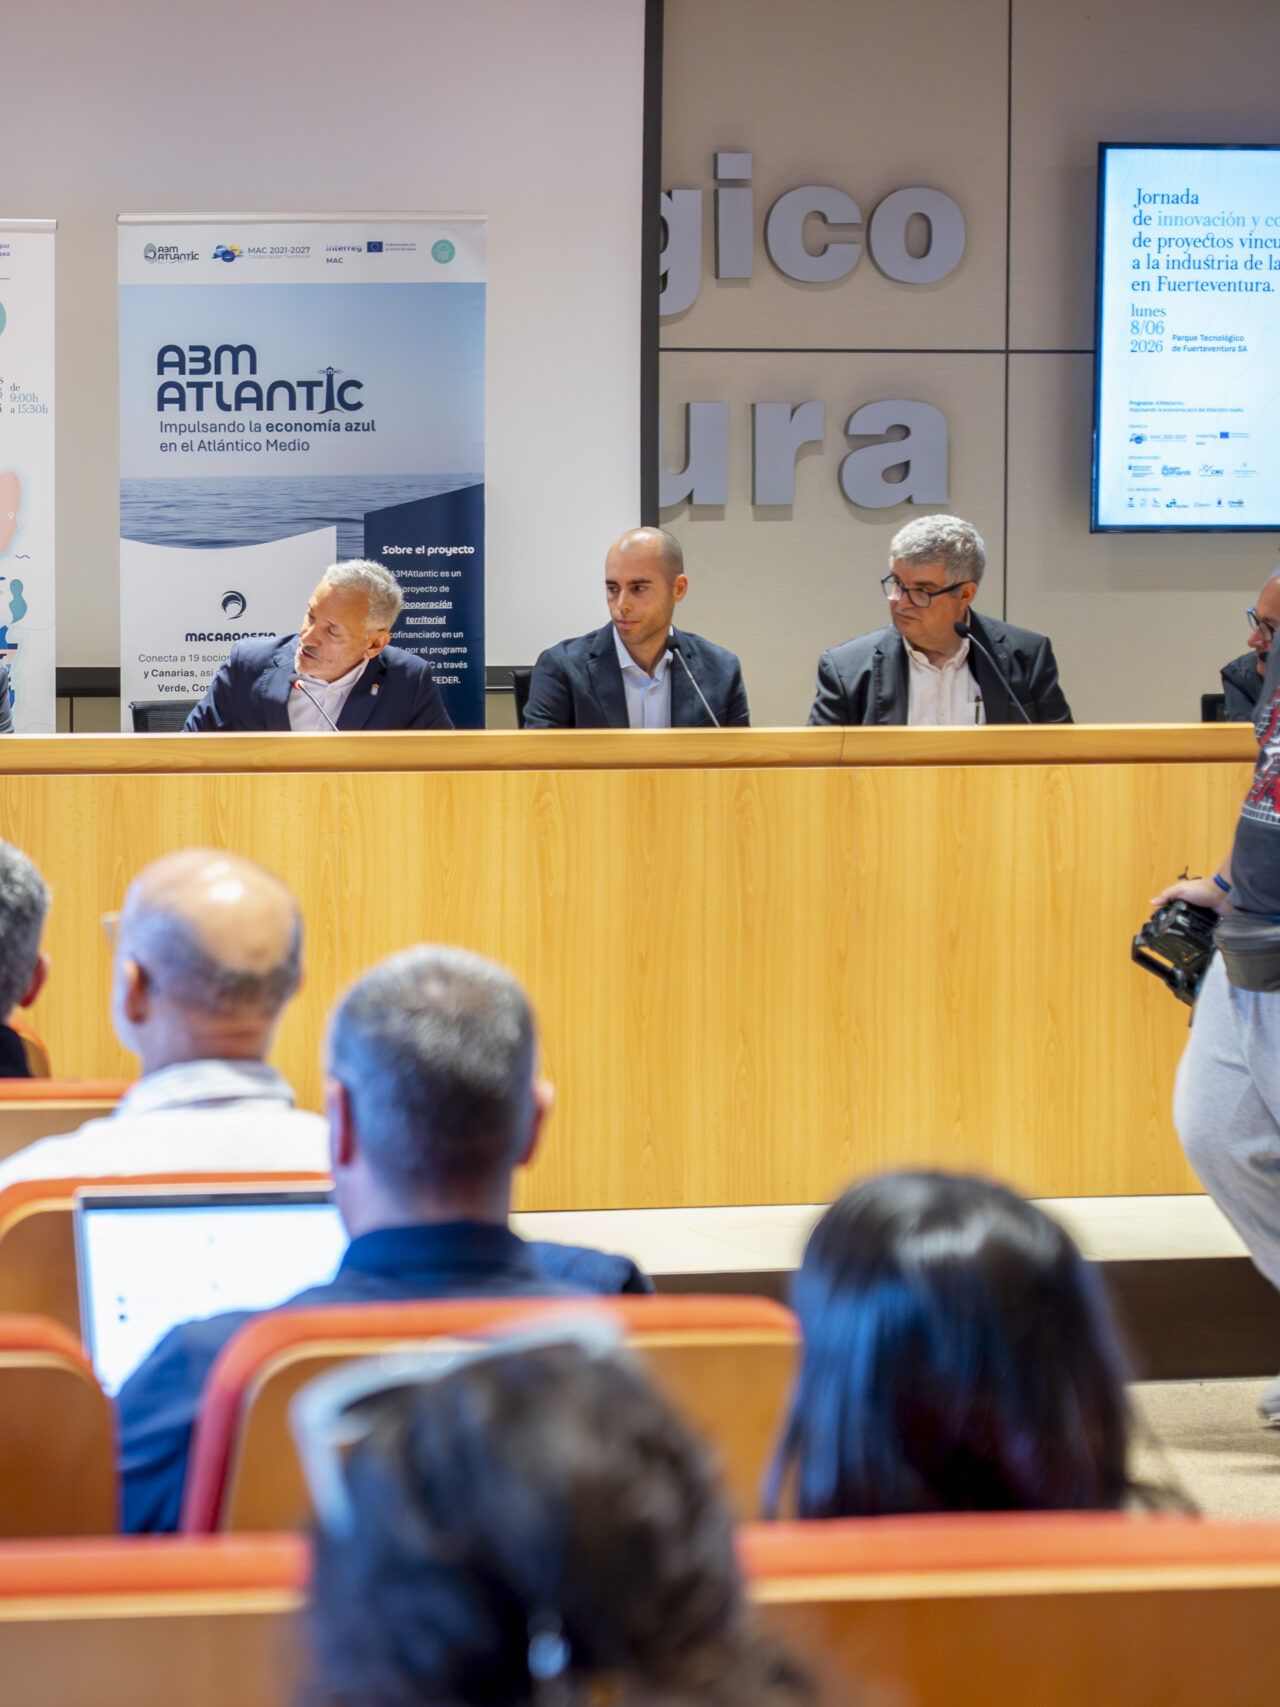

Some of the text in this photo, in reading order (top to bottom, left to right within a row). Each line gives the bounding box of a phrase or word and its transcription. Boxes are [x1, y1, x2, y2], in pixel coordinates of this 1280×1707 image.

[1133, 188, 1199, 208] Jornada
[1133, 209, 1152, 226] de
[1157, 210, 1246, 227] innovación
[1249, 216, 1261, 233] y
[326, 243, 362, 253] Interreg
[1132, 231, 1280, 254] de proyectos vincu
[269, 246, 310, 254] 2021-2027
[1132, 253, 1280, 270] a la industria de la
[1131, 275, 1275, 292] en Fuerteventura.
[1131, 303, 1167, 317] lunes
[1130, 320, 1165, 336] 8/06
[1172, 334, 1245, 343] Parque Tecnológico
[1130, 340, 1163, 353] 2026
[1172, 344, 1181, 352] de
[1183, 344, 1236, 352] Fuerteventura
[157, 344, 257, 375] A3M
[10, 382, 21, 392] de
[157, 366, 365, 414] ATLANTIC
[10, 392, 39, 403] 9:00h
[18, 404, 48, 414] 15:30h
[159, 419, 376, 437] Impulsando la economía azul
[159, 438, 310, 452] en el Atlántico Medio
[382, 545, 475, 557] Sobre el proyecto
[402, 585, 450, 594] proyecto de
[405, 615, 447, 625] territorial
[429, 647, 467, 655] programa
[138, 654, 178, 662] Conecta
[189, 654, 200, 662] 19
[443, 661, 468, 669] través
[143, 669, 214, 679] y Canarias, así
[157, 684, 210, 693] Verde, Cos
